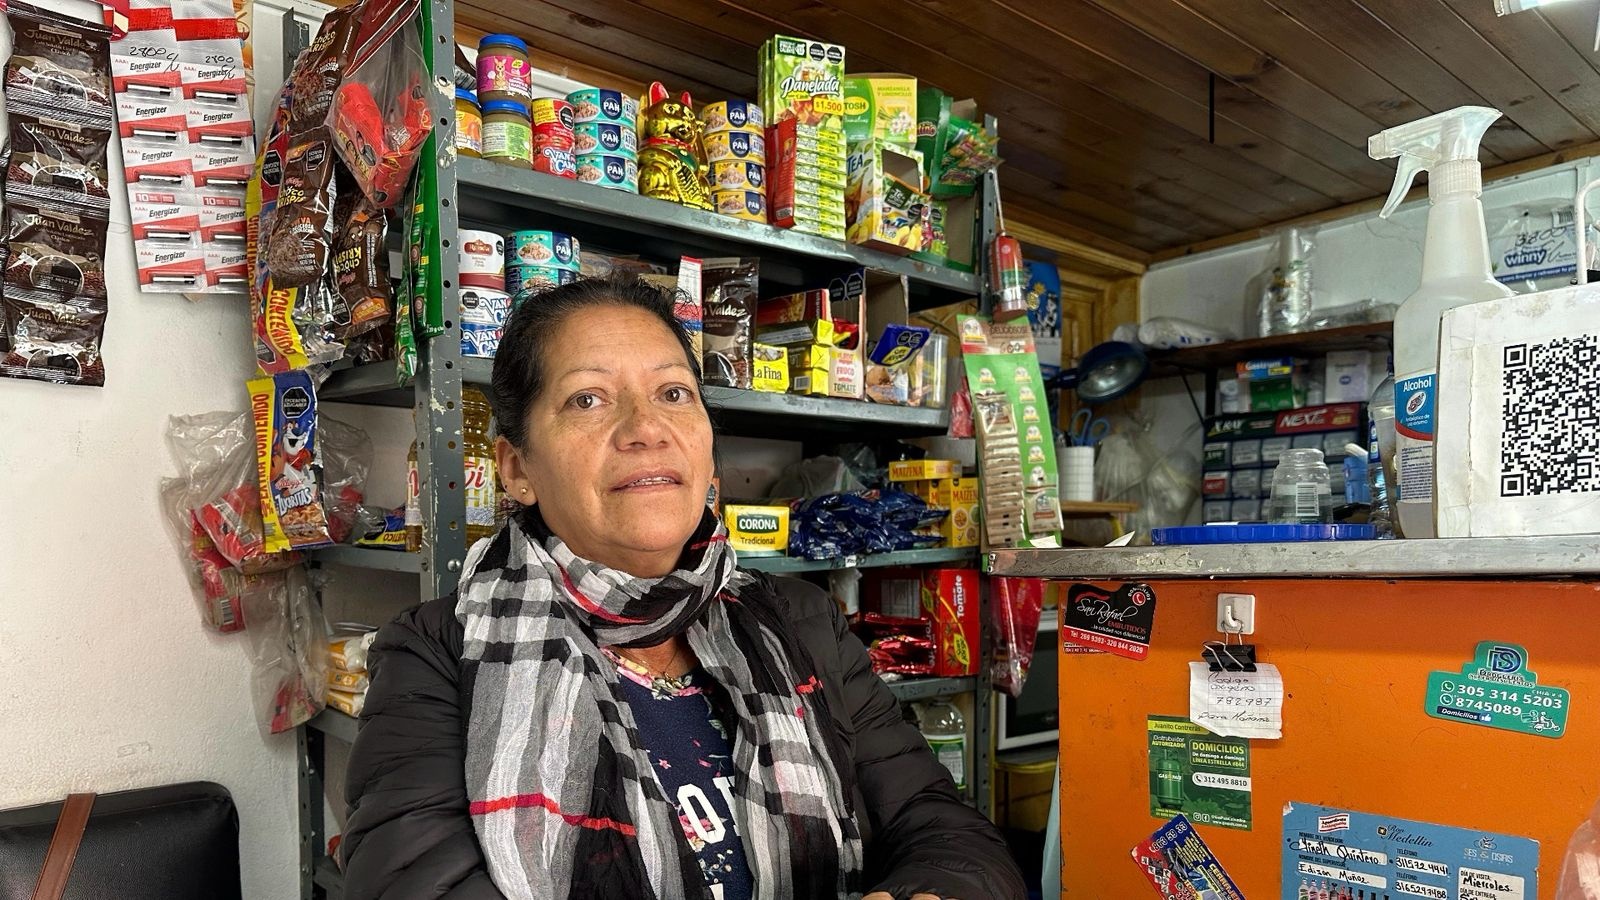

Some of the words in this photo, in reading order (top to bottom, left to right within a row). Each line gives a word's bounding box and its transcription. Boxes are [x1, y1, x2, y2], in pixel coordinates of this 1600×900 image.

[24, 29, 55, 42] Juan
[130, 46, 167, 57] 2800
[205, 55, 234, 64] 2800
[130, 61, 162, 72] Energizer
[197, 68, 228, 80] Energizer
[781, 76, 840, 99] Panelada
[135, 105, 168, 117] Energizer
[603, 102, 620, 112] PAN
[843, 102, 866, 110] TOSH
[203, 111, 234, 123] Energizer
[729, 111, 746, 121] PAN
[55, 129, 96, 146] Valdez
[601, 133, 619, 144] PAN
[732, 142, 748, 151] PAN
[141, 150, 174, 162] Energizer
[208, 154, 239, 167] Energizer
[607, 166, 624, 177] PAN
[136, 193, 149, 202] 10
[204, 197, 216, 206] 10
[149, 206, 181, 218] Energizer
[215, 209, 246, 222] Energizer
[23, 213, 55, 228] Juan
[56, 222, 95, 236] Valdez
[154, 251, 186, 263] Energizer
[555, 245, 572, 257] PAN
[1506, 250, 1546, 265] winny
[24, 306, 52, 322] Juan
[54, 312, 91, 327] Valdez
[709, 304, 748, 317] Valdez
[463, 330, 496, 346] VAN
[764, 366, 782, 380] Fina
[833, 383, 857, 393] TOMATE
[1403, 376, 1432, 392] Alcohol
[252, 394, 270, 454] CONTENIDO
[892, 465, 923, 478] MAIZENA
[952, 489, 978, 501] MAIZEN
[739, 517, 778, 531] CORONA
[740, 536, 776, 546] Tradicional
[955, 575, 965, 618] Tomate
[1077, 598, 1097, 616] San
[1094, 600, 1139, 624] Rafael
[1457, 684, 1485, 697] 305
[1489, 689, 1518, 702] 314
[1522, 694, 1562, 709] 5203
[1455, 697, 1522, 717] 8745089
[1441, 707, 1478, 721] Domicilios
[1153, 722, 1174, 730] Juanito
[1175, 723, 1201, 732] Contreras
[1192, 741, 1244, 755] DOMICILIOS
[1203, 775, 1217, 783] 312
[1218, 777, 1229, 785] 495
[1230, 778, 1248, 787] 8810
[1337, 844, 1380, 864] Quintero
